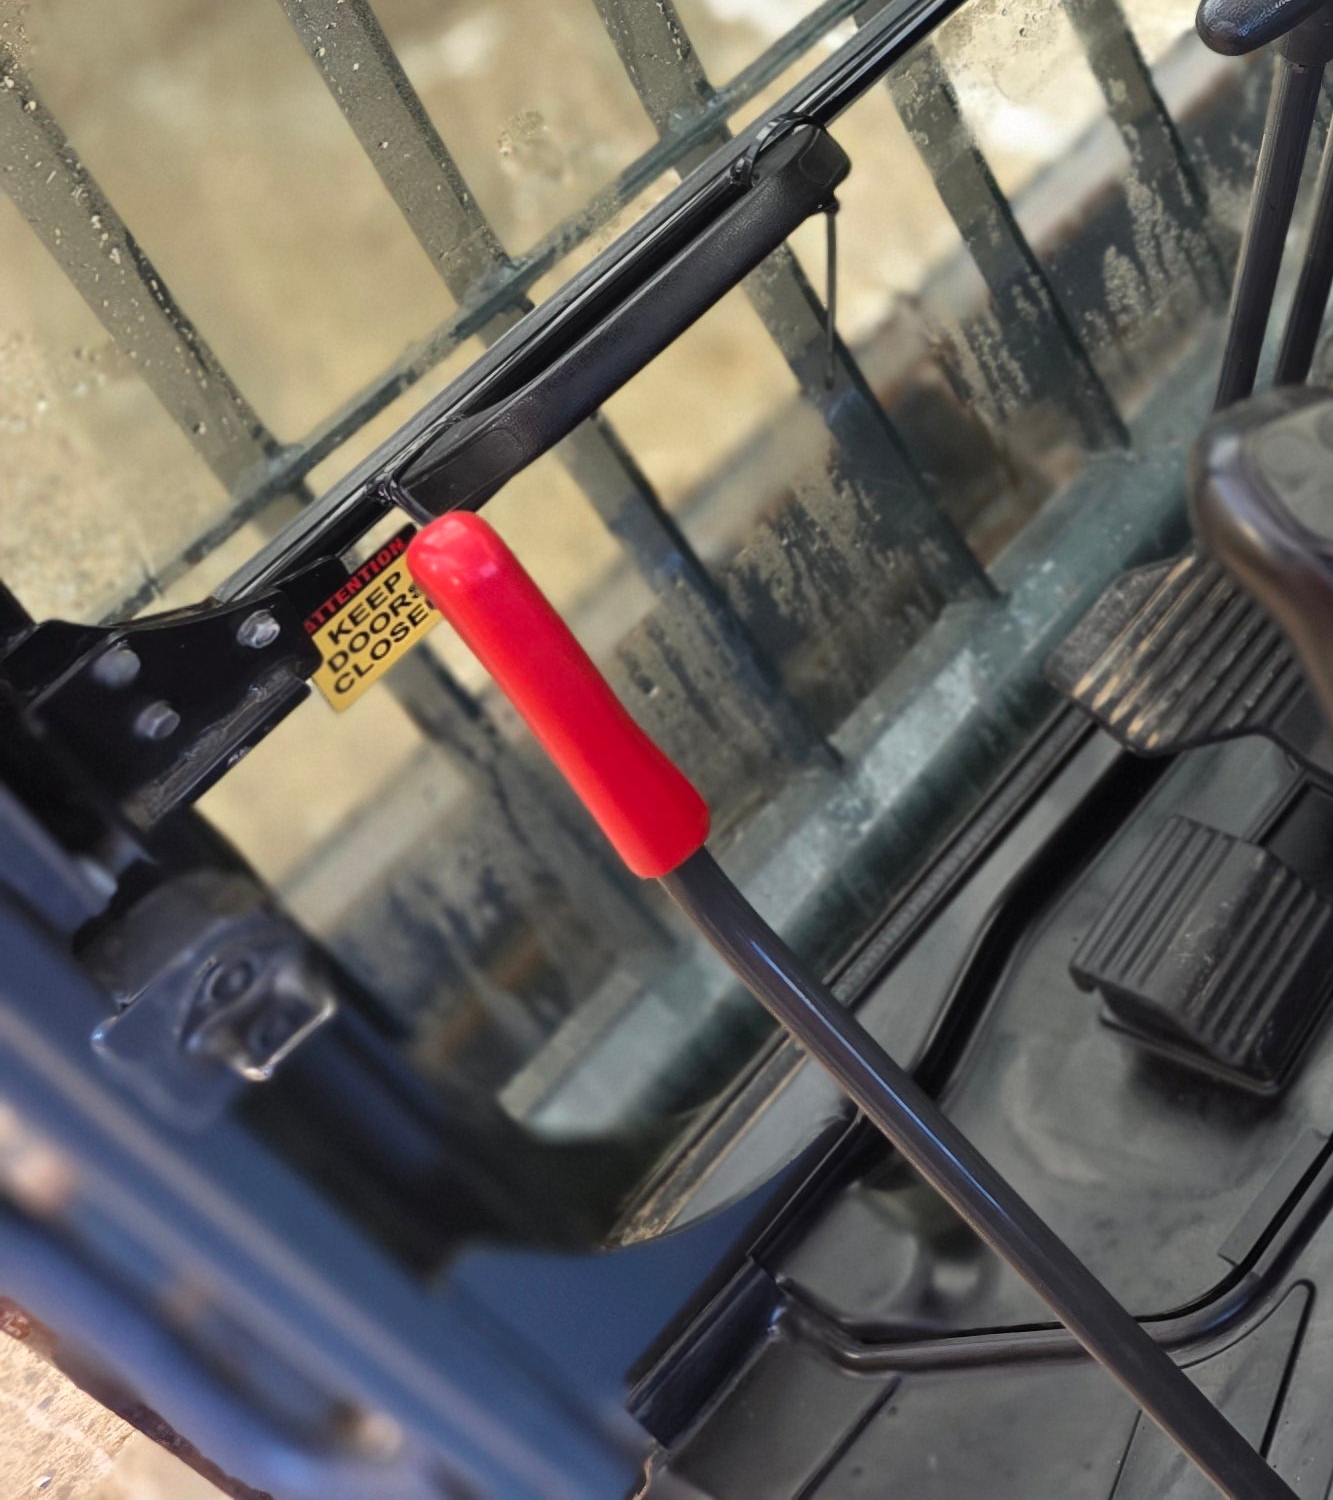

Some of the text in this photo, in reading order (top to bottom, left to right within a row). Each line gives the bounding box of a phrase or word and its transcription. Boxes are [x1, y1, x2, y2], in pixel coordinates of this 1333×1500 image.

[303, 538, 405, 634] ATTENTION
[327, 571, 402, 645] KEEP
[333, 597, 437, 694] CLOSE
